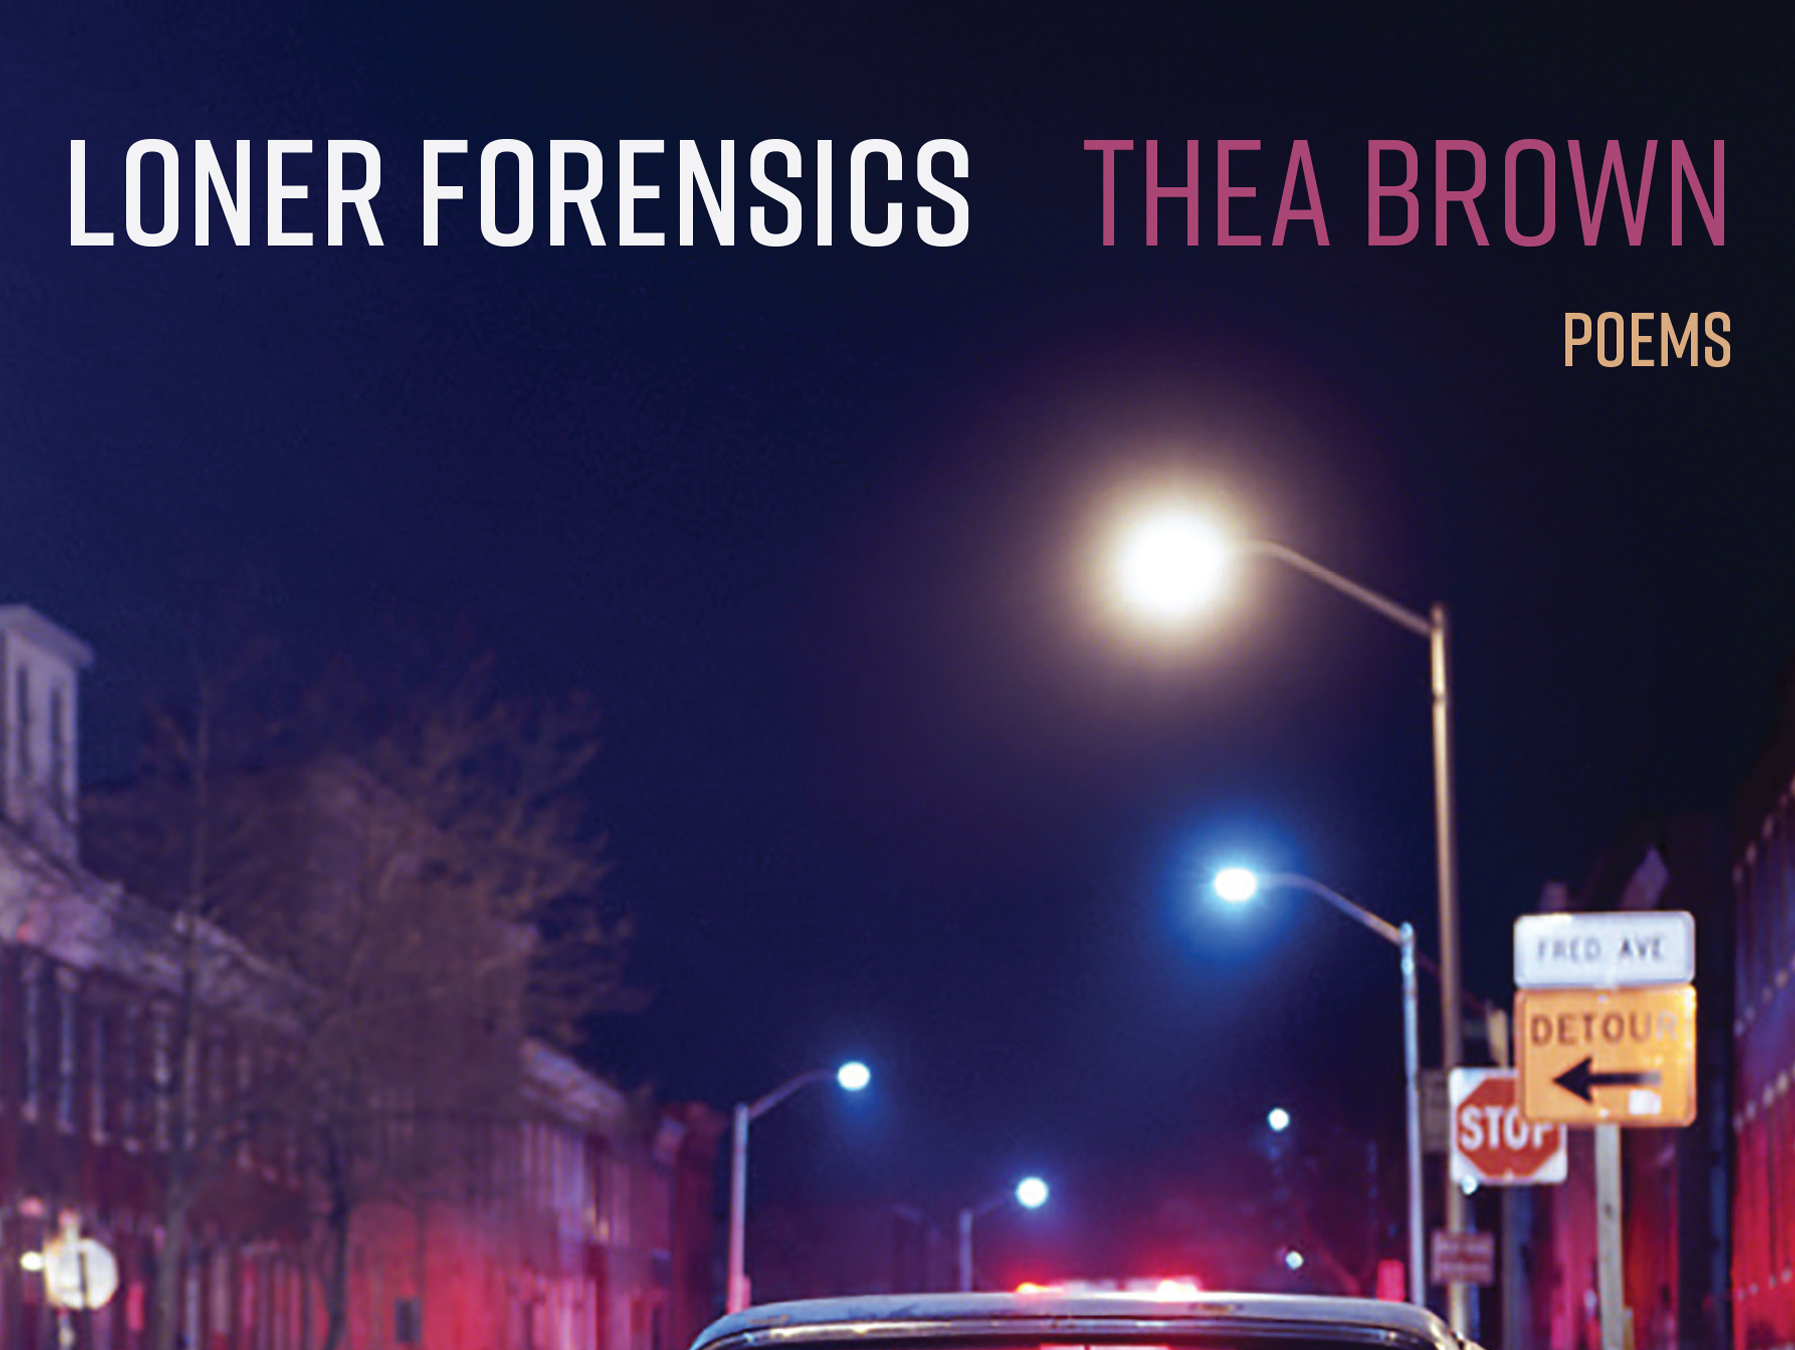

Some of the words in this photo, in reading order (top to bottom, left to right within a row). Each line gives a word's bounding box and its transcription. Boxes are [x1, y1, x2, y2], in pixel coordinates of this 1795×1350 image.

[1537, 936, 1602, 963] FRED
[1619, 935, 1664, 961] AVE
[1530, 1010, 1678, 1046] DETOUR
